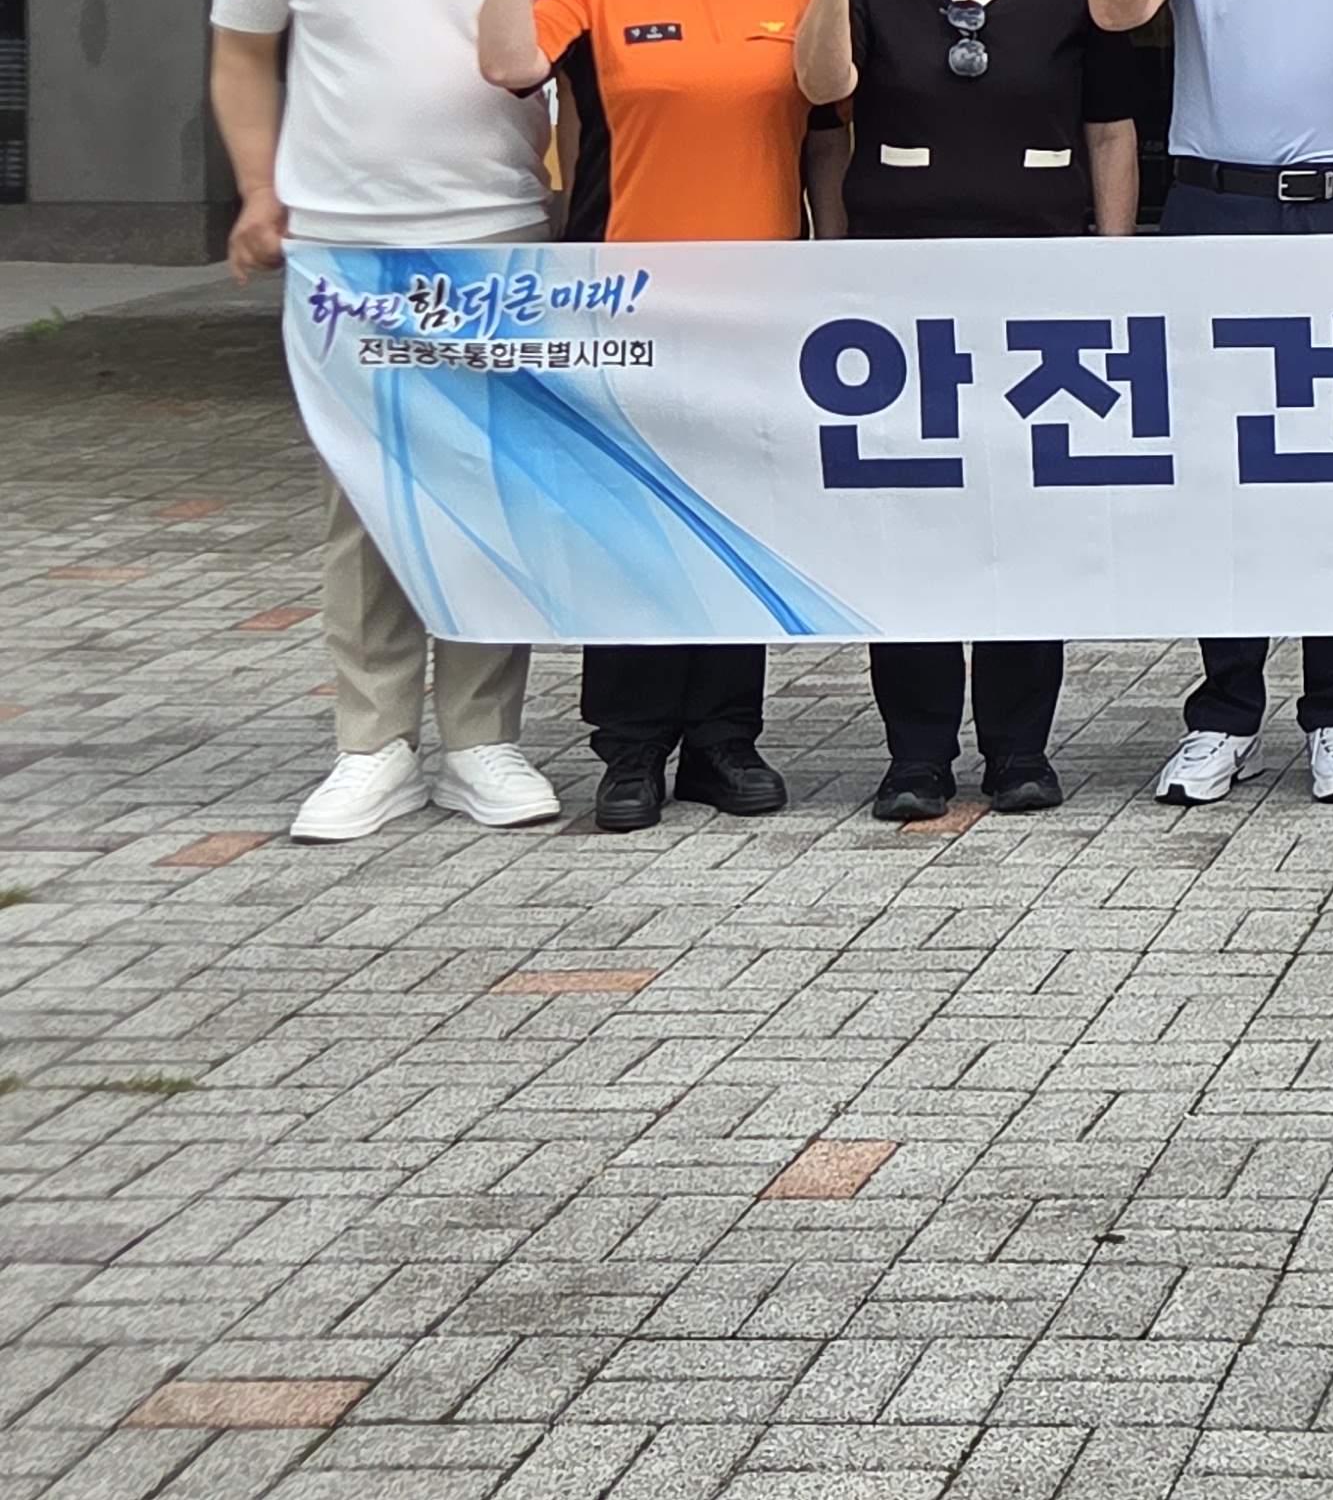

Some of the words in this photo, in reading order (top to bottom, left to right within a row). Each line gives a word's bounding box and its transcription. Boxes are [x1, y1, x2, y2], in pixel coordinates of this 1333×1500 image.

[307, 277, 401, 362] 하나된
[408, 277, 461, 332] 힘,
[457, 276, 500, 339] 더
[504, 273, 543, 322] 큰
[551, 269, 649, 319] 미래!
[357, 337, 655, 369] 전남광주통합특별시의회
